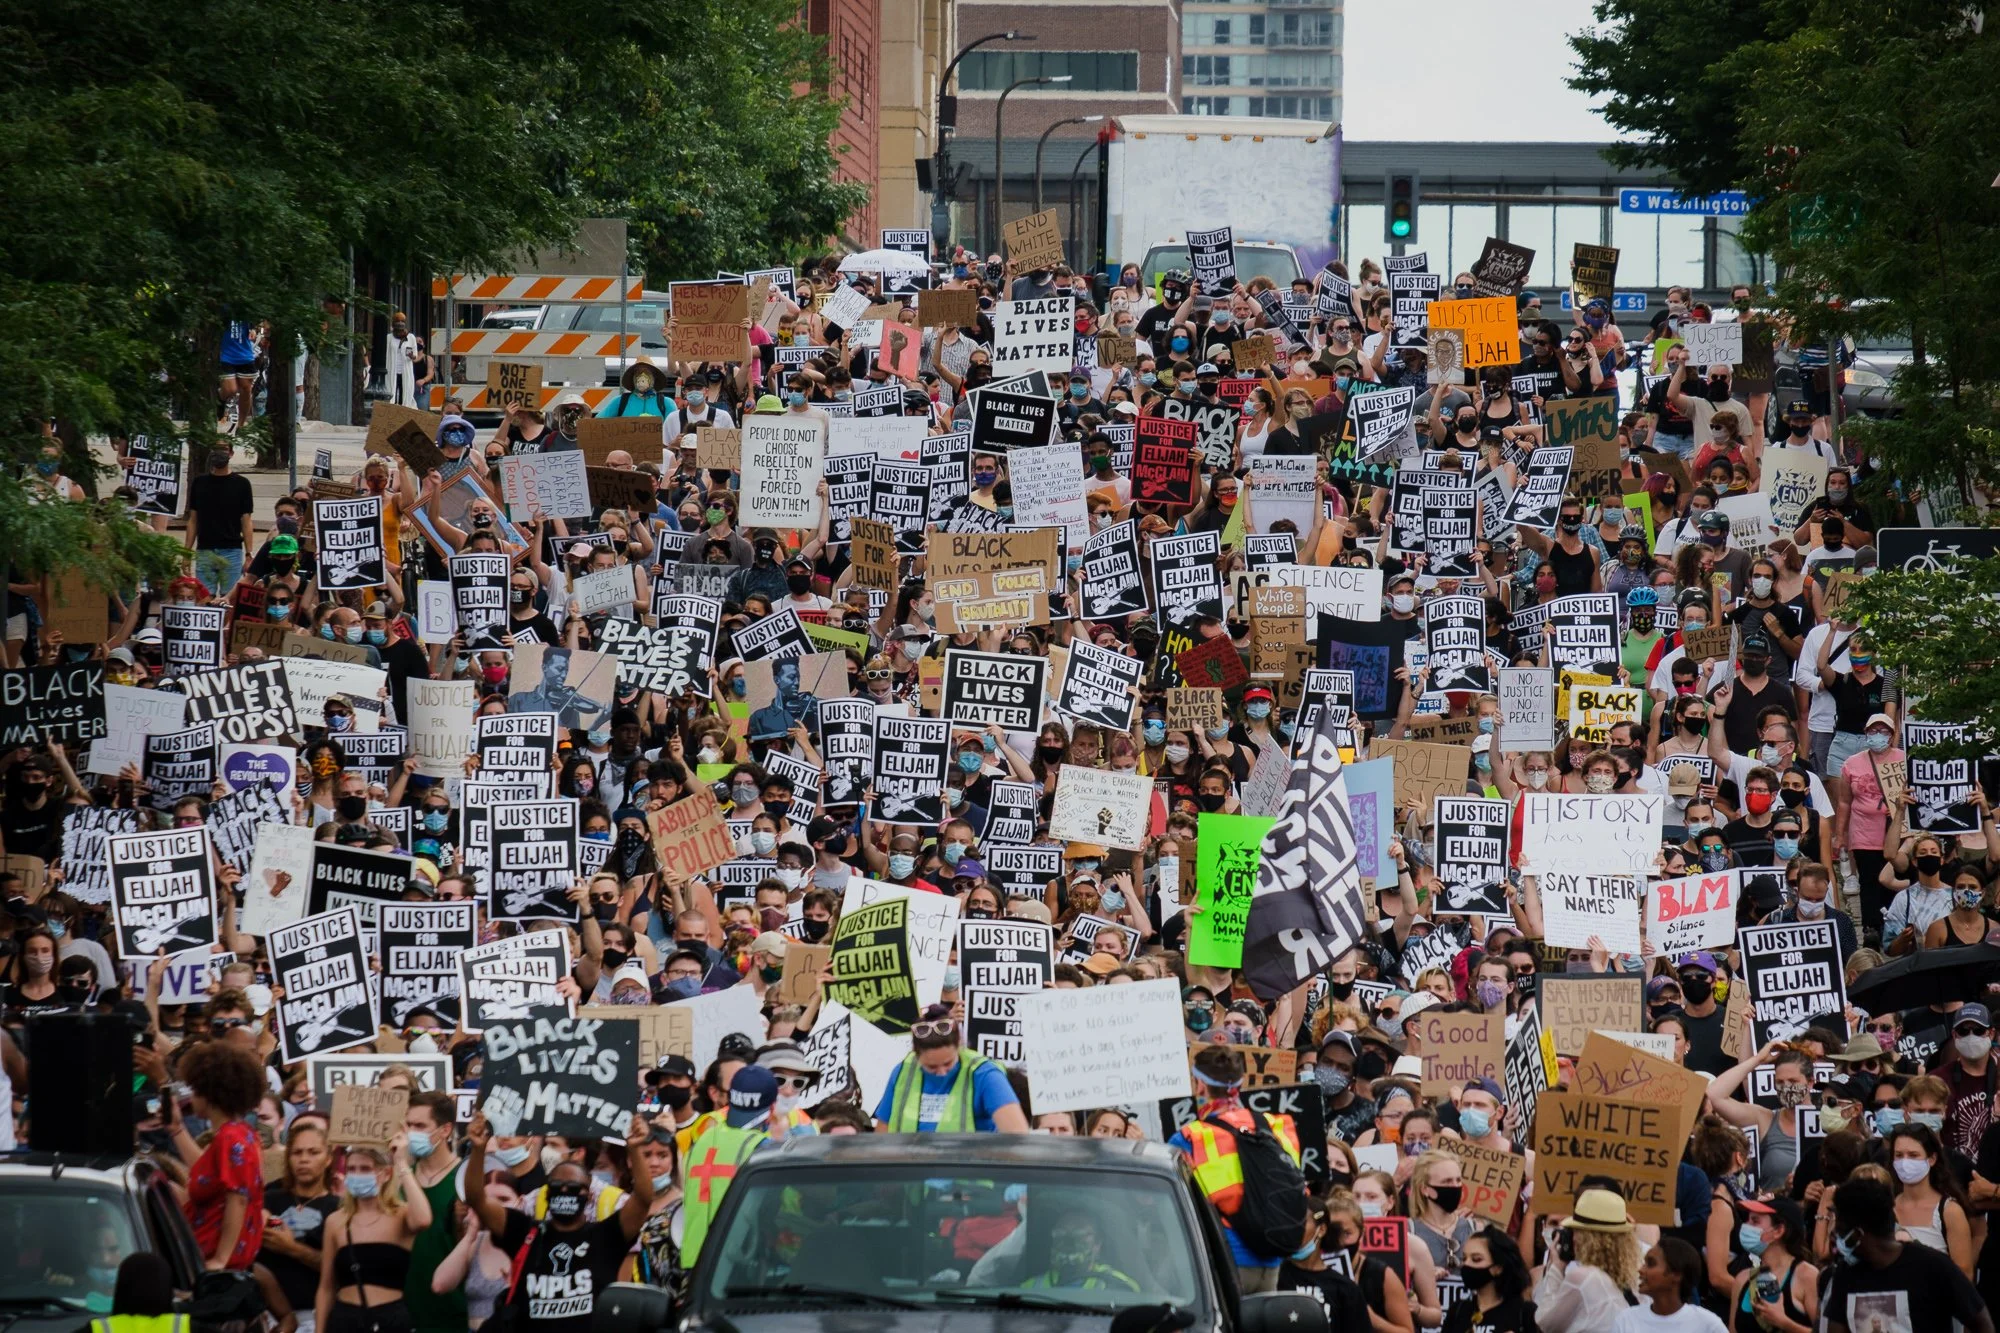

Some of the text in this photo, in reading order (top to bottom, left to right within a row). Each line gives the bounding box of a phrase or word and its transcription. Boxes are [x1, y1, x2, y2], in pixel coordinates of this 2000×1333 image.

[1629, 195, 1639, 208] S
[1015, 213, 1048, 236] END
[885, 231, 926, 244] JUSTICE
[1009, 234, 1058, 255] WHITE
[1190, 230, 1229, 245] JUSTICE
[1011, 248, 1064, 275] SUPREMACY
[1196, 252, 1230, 266] ELIJAH
[1395, 277, 1436, 289] JUSTICE
[674, 286, 741, 305] HERE Piggy
[1628, 297, 1643, 308] St
[1014, 298, 1070, 315] BLACK
[1432, 302, 1506, 327] JUSTICE
[1004, 318, 1070, 335] LIVES
[997, 344, 1070, 361] MATTER
[500, 364, 530, 378] NOT
[502, 376, 526, 390] ONE
[486, 388, 534, 408] MORE
[857, 391, 897, 407] JUSTICE
[1360, 392, 1410, 411] JUSTICE
[986, 400, 1045, 417] BLACK LIVES
[998, 418, 1030, 431] MATTER
[1142, 420, 1192, 438] JUSTICE
[750, 426, 781, 442] PEOPLE
[766, 442, 798, 455] CHOOSE
[924, 439, 966, 455] JUSTICE
[754, 455, 813, 469] REBELLION
[1533, 450, 1571, 466] JUSTICE
[534, 456, 552, 500] TO GET
[767, 468, 798, 481] IT IS
[876, 470, 926, 485] JUSTICE
[521, 465, 540, 512] GOOD
[548, 456, 568, 516] BE AFRAID
[564, 454, 584, 514] NEVER EVER
[761, 481, 801, 495] FORCED
[892, 484, 907, 494] FOR
[1530, 479, 1559, 489] ELIJAH
[878, 495, 919, 512] ELIJAH
[1425, 491, 1472, 507] JUSTICE
[1781, 488, 1808, 503] END
[321, 502, 376, 520] JUSTICE
[752, 497, 809, 513] UPON THEM
[1440, 509, 1455, 518] FOR
[341, 519, 358, 530] FOR
[1428, 521, 1468, 536] ELIJAH
[328, 530, 371, 548] ELIJAH
[852, 524, 894, 545] JUSTICE
[1085, 528, 1129, 553] JUSTICE
[864, 543, 885, 562] FOR
[953, 536, 1012, 558] BLACK
[1159, 539, 1213, 557] JUSTICE
[1248, 538, 1290, 553] JUSTICE
[454, 559, 504, 575] JUSTICE
[1088, 556, 1129, 579] ELIJAH
[1179, 556, 1195, 567] FOR
[472, 577, 488, 586] FOR
[855, 567, 894, 591] ELIJAH
[997, 574, 1041, 590] POLICE
[1166, 569, 1211, 585] ELIJAH
[1275, 568, 1365, 592] SILENCE
[461, 589, 500, 605] ELIJAH
[938, 583, 974, 598] END
[1256, 589, 1294, 603] White
[663, 597, 716, 620] JUSTICE
[958, 599, 1030, 620] BRUTALITY
[1255, 602, 1300, 615] People:
[1430, 602, 1481, 620] JUSTICE
[1553, 599, 1611, 616] JUSTICE
[165, 610, 219, 630] JUSTICE
[1260, 620, 1299, 635] Start
[1447, 617, 1464, 627] FOR
[1574, 615, 1591, 625] FOR
[182, 630, 200, 640] FOR
[743, 615, 794, 651] JUSTICE
[1435, 630, 1478, 647] ELIJAH
[1561, 629, 1606, 644] ELIJAH
[169, 641, 212, 662] ELIJAH
[1078, 643, 1136, 674] JUSTICE
[959, 661, 1033, 682] BLACK
[1078, 666, 1125, 693] ELIJAH
[4, 669, 104, 705] BLACK
[1311, 674, 1350, 692] JUSTICE
[962, 681, 1026, 704] LIVES
[1173, 689, 1216, 704] BLACK
[26, 704, 84, 721] Lives
[954, 706, 1028, 728] MATTER
[2, 718, 105, 745] MATTER
[485, 718, 548, 734] JUSTICE
[882, 722, 944, 741] JUSTICE
[1413, 720, 1474, 740] SAY THEIR
[152, 730, 210, 750] JUSTICE
[506, 735, 525, 746] FOR
[902, 741, 921, 753] FOR
[246, 759, 268, 770] THE
[489, 751, 540, 767] ELIJAH
[885, 757, 935, 775] ELIJAH
[230, 770, 286, 783] REVOLUTION
[1916, 763, 1965, 781] ELIJAH
[996, 786, 1032, 807] JUSTICE
[498, 806, 569, 826] JUSTICE
[657, 791, 716, 834] ABOLISH
[1444, 804, 1504, 823] JUSTICE
[1529, 797, 1660, 825] HISTORY
[523, 828, 544, 841] FOR
[681, 825, 701, 838] THE
[1469, 824, 1486, 837] FOR
[119, 835, 198, 861] JUSTICE
[505, 845, 563, 865] ELIJAH
[663, 827, 735, 874] POLICE
[1450, 840, 1498, 859] ELIJAH
[148, 860, 172, 874] FOR
[995, 853, 1057, 872] JUSTICE
[130, 875, 194, 899] ELIJAH
[1015, 872, 1034, 884] FOR
[1545, 873, 1638, 900] SAY THEIR
[1565, 896, 1617, 914] NAMES
[1657, 874, 1731, 922] BLM
[388, 908, 466, 930] JUSTICE
[839, 910, 900, 938] JUSTICE
[277, 917, 350, 955] JUSTICE
[415, 932, 439, 946] FOR
[969, 927, 1042, 948] JUSTICE
[1751, 928, 1828, 952] JUSTICE
[304, 945, 328, 962] FOR
[995, 949, 1018, 962] FOR
[1780, 951, 1804, 964] FOR
[480, 960, 549, 979] ELIJAH
[837, 951, 894, 976] ELIJAH
[289, 964, 352, 994] ELIJAH
[976, 966, 1037, 985] ELIJAH
[1763, 967, 1826, 993] ELIJAH
[486, 1018, 603, 1062] BLACK
[1427, 1018, 1489, 1045] Good
[519, 1047, 619, 1084] LIVES
[1423, 1053, 1496, 1083] Trouble
[347, 1085, 402, 1105] DEFUND
[353, 1104, 381, 1120] THE
[1560, 1102, 1661, 1139] WHITE
[341, 1119, 392, 1138] POLICE
[1437, 1135, 1520, 1170] PROSECUTE
[1541, 1132, 1669, 1167] SILENCE IS
[527, 1274, 593, 1300] MPLS
[532, 1298, 590, 1318] STRONG
